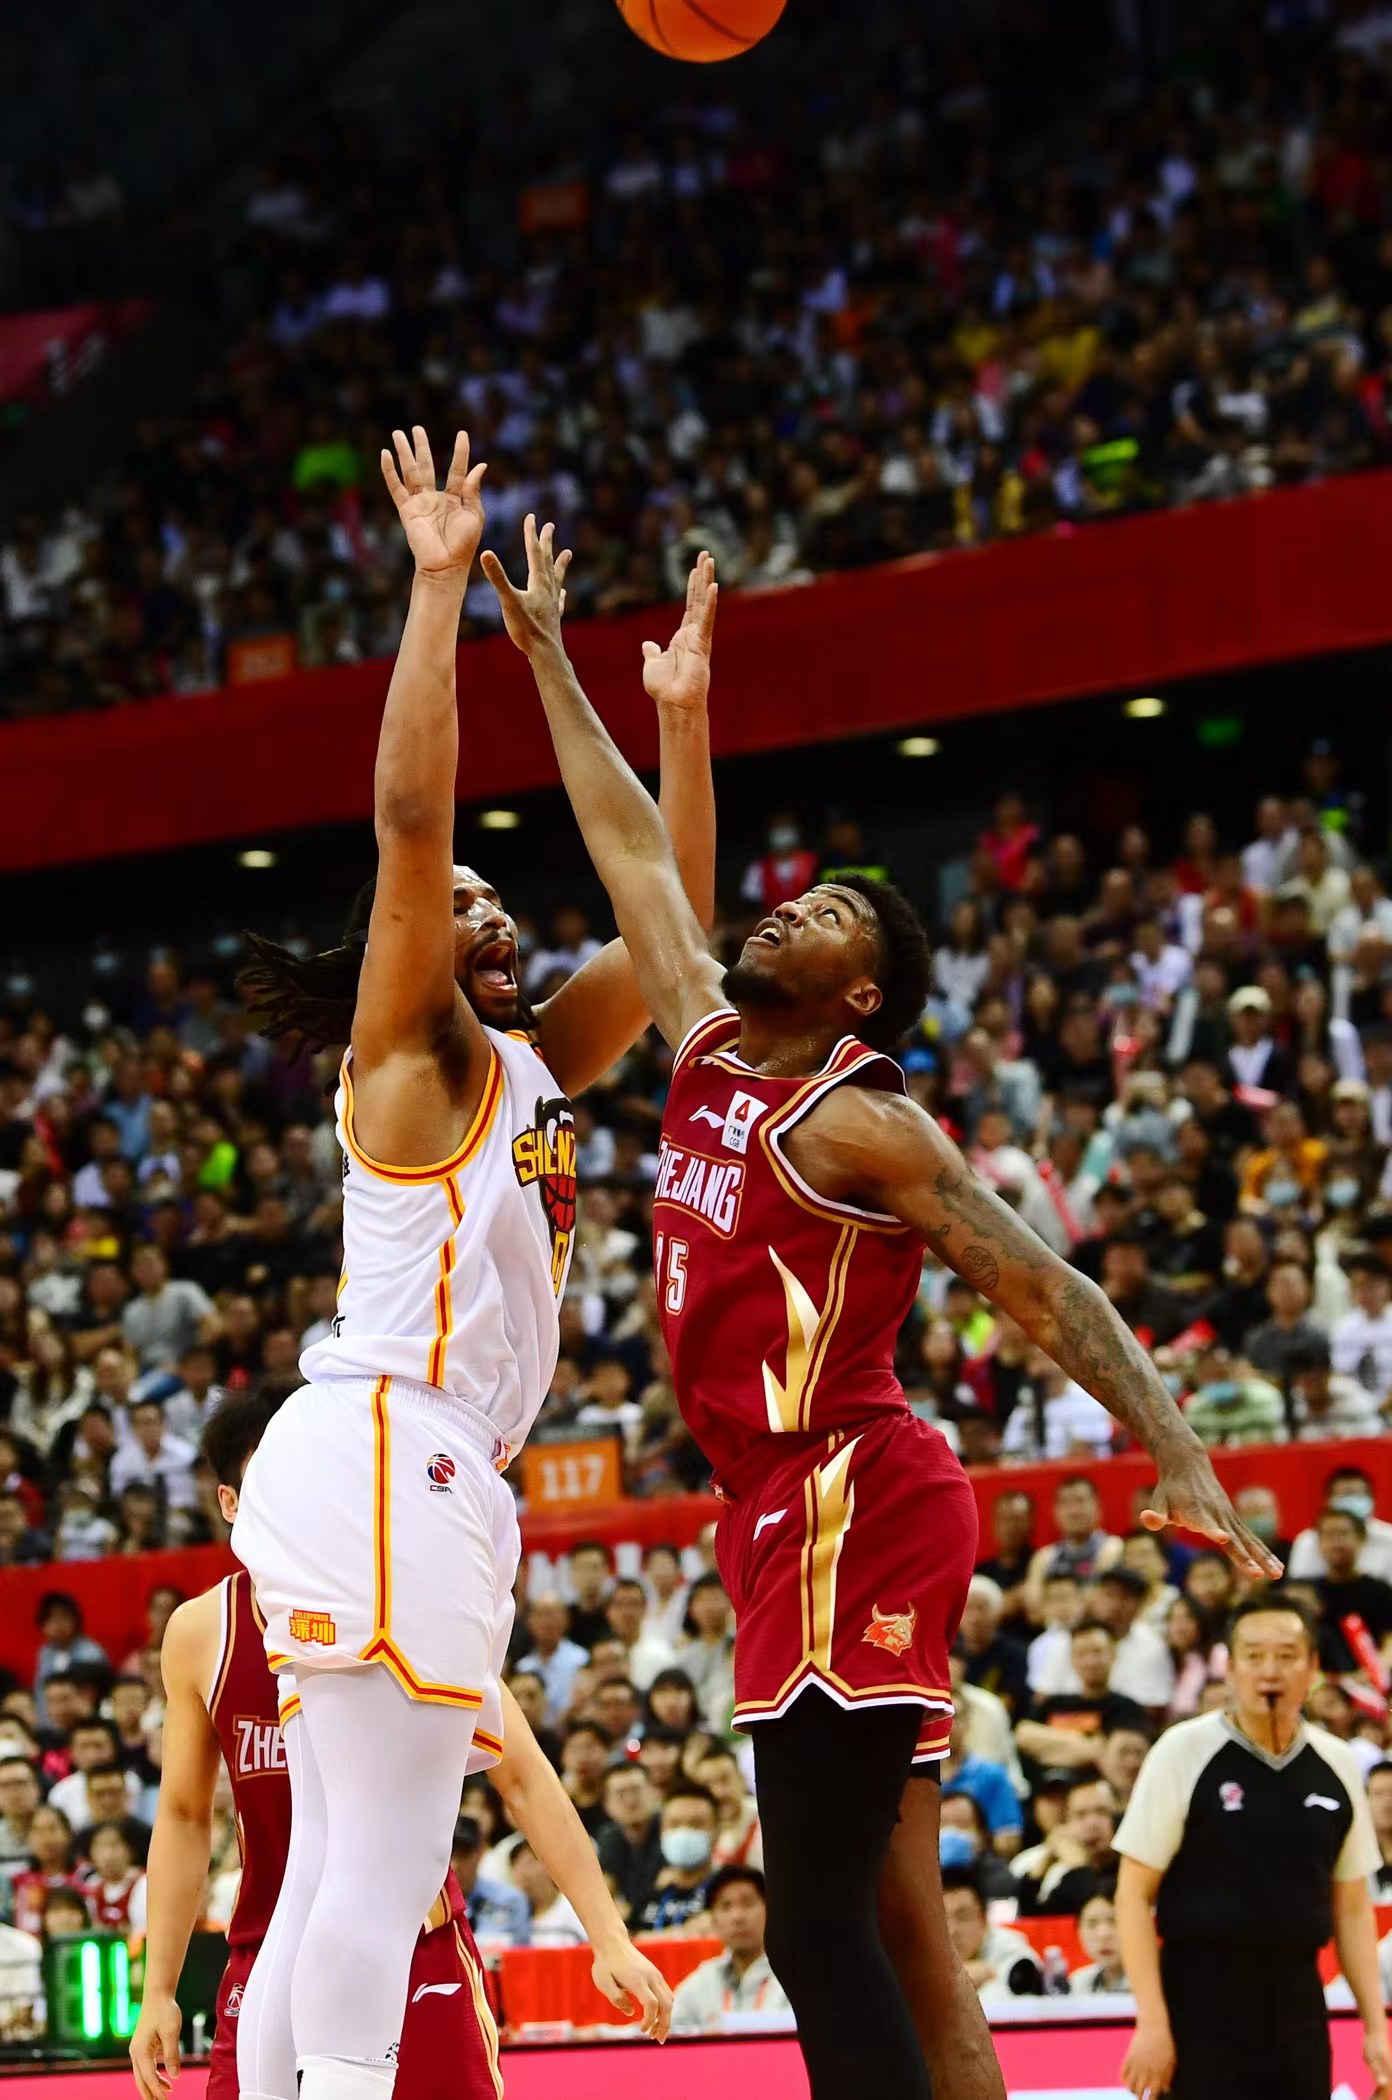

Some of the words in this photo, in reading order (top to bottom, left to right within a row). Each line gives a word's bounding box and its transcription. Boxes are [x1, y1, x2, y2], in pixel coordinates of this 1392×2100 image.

[429, 1484, 453, 1494] CBA
[542, 1454, 604, 1500] 117
[289, 1617, 335, 1645] 深圳
